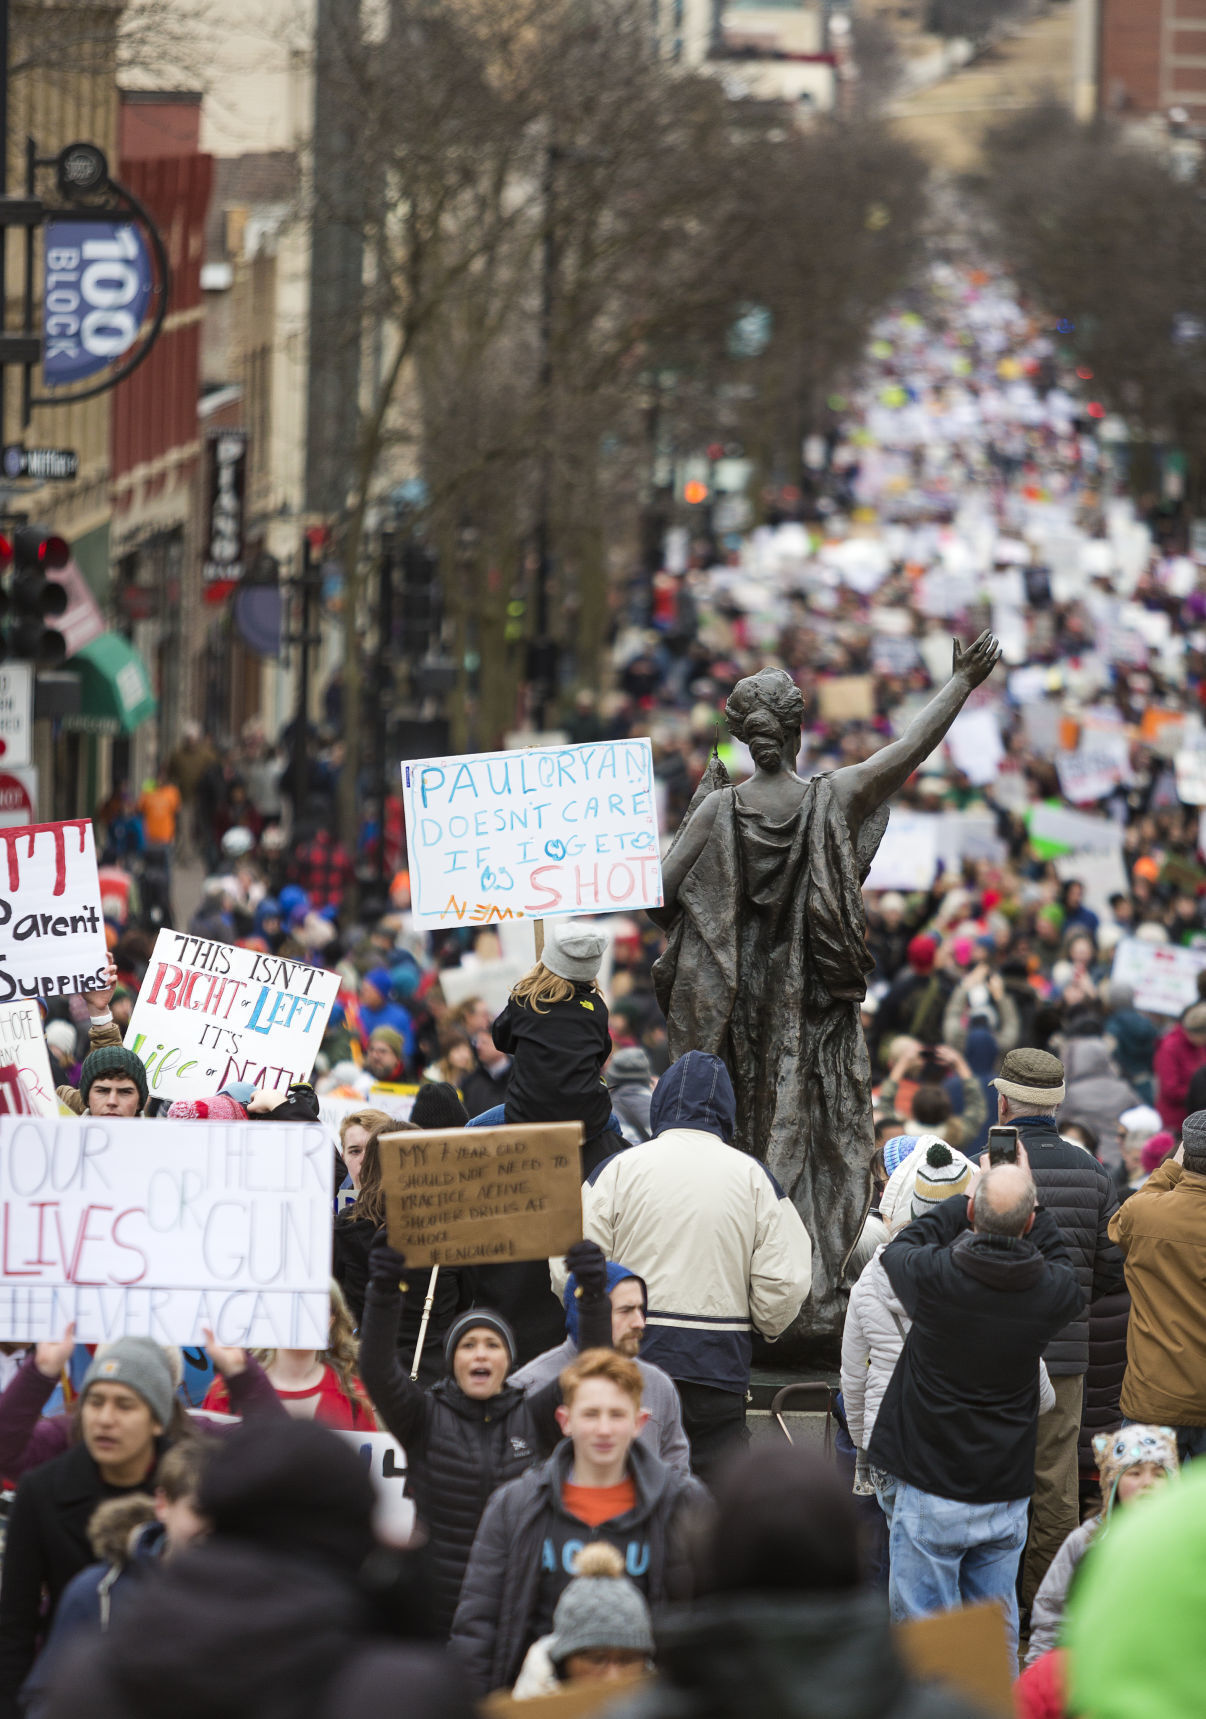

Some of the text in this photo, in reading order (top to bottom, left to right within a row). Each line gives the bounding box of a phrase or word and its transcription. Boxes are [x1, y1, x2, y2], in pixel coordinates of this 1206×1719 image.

[46, 247, 80, 359] BLOCK
[80, 227, 139, 357] 100
[420, 760, 537, 809] PAUL
[556, 745, 647, 788] RYAN
[561, 791, 648, 823] CARE
[443, 832, 635, 874] IF I GET
[523, 854, 658, 911] SHOT
[174, 934, 324, 996] THIS ISN'T
[146, 962, 326, 1035] RIGHT or LEFT
[198, 1023, 243, 1055] IT'S
[205, 1067, 218, 1077] or
[8, 1121, 327, 1197] OUR THEIR
[399, 1142, 429, 1168] MY
[455, 1148, 489, 1160] YEAR
[400, 1172, 454, 1190] SHOULD
[2, 1166, 313, 1286] LIVES OR GUN
[524, 1197, 546, 1212] AT
[189, 1289, 329, 1347] AGAIN
